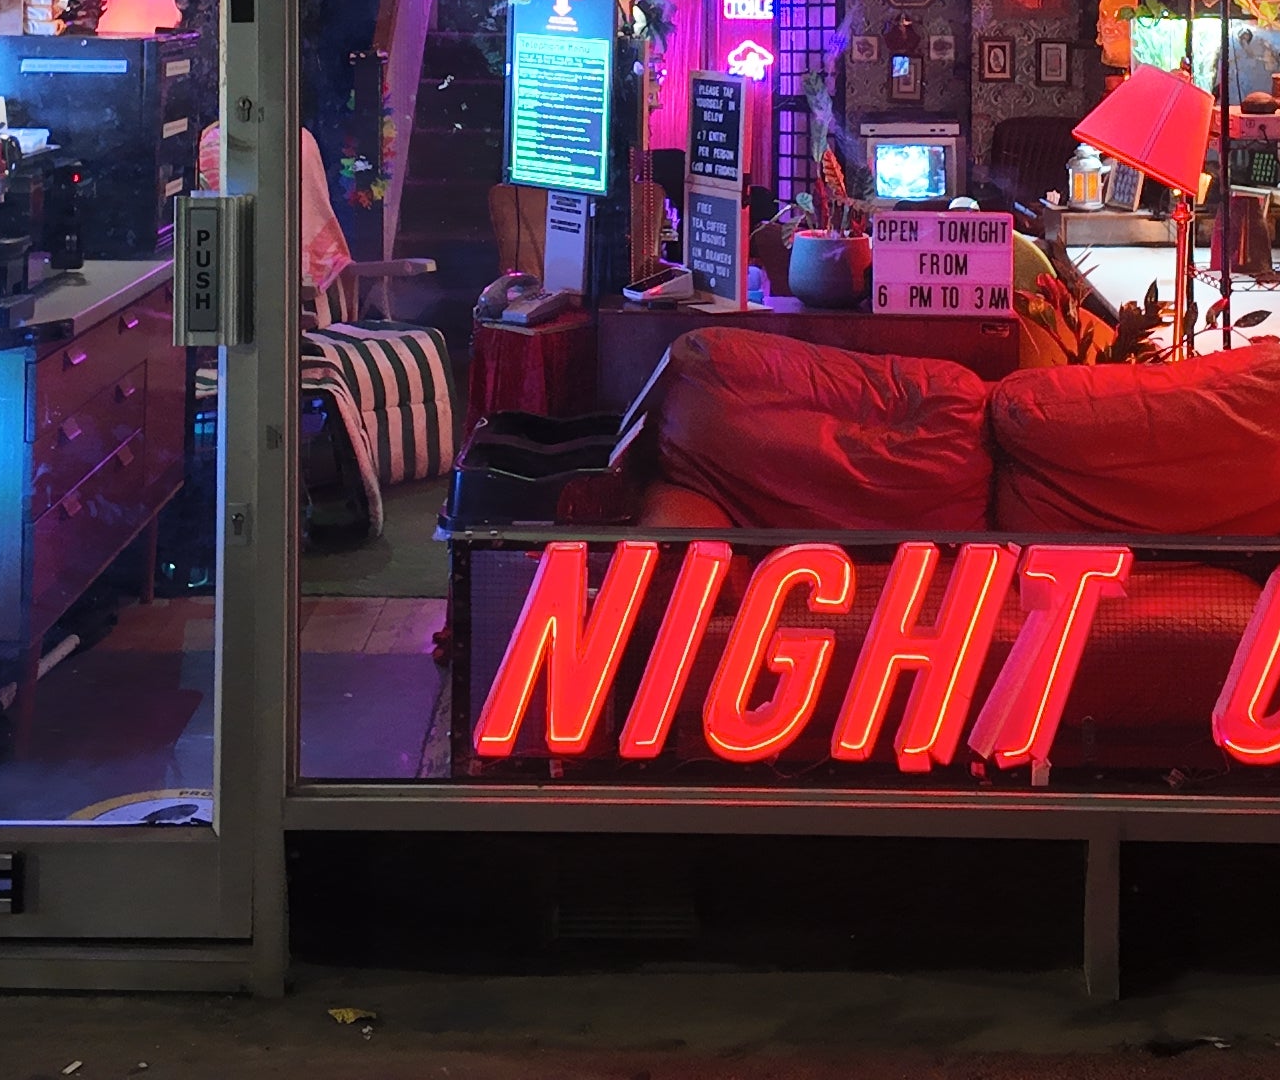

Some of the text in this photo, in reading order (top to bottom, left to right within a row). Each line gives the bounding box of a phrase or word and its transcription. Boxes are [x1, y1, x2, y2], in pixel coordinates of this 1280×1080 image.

[698, 84, 734, 99] PLEASE TAP
[703, 110, 724, 123] BELOW
[696, 202, 712, 215] FREE
[877, 219, 919, 242] OPEN
[195, 229, 211, 310] PUSH
[919, 253, 968, 276] FROM
[878, 285, 1010, 309] 6 PM TO 3 AM
[474, 540, 1134, 780] NIGHT
